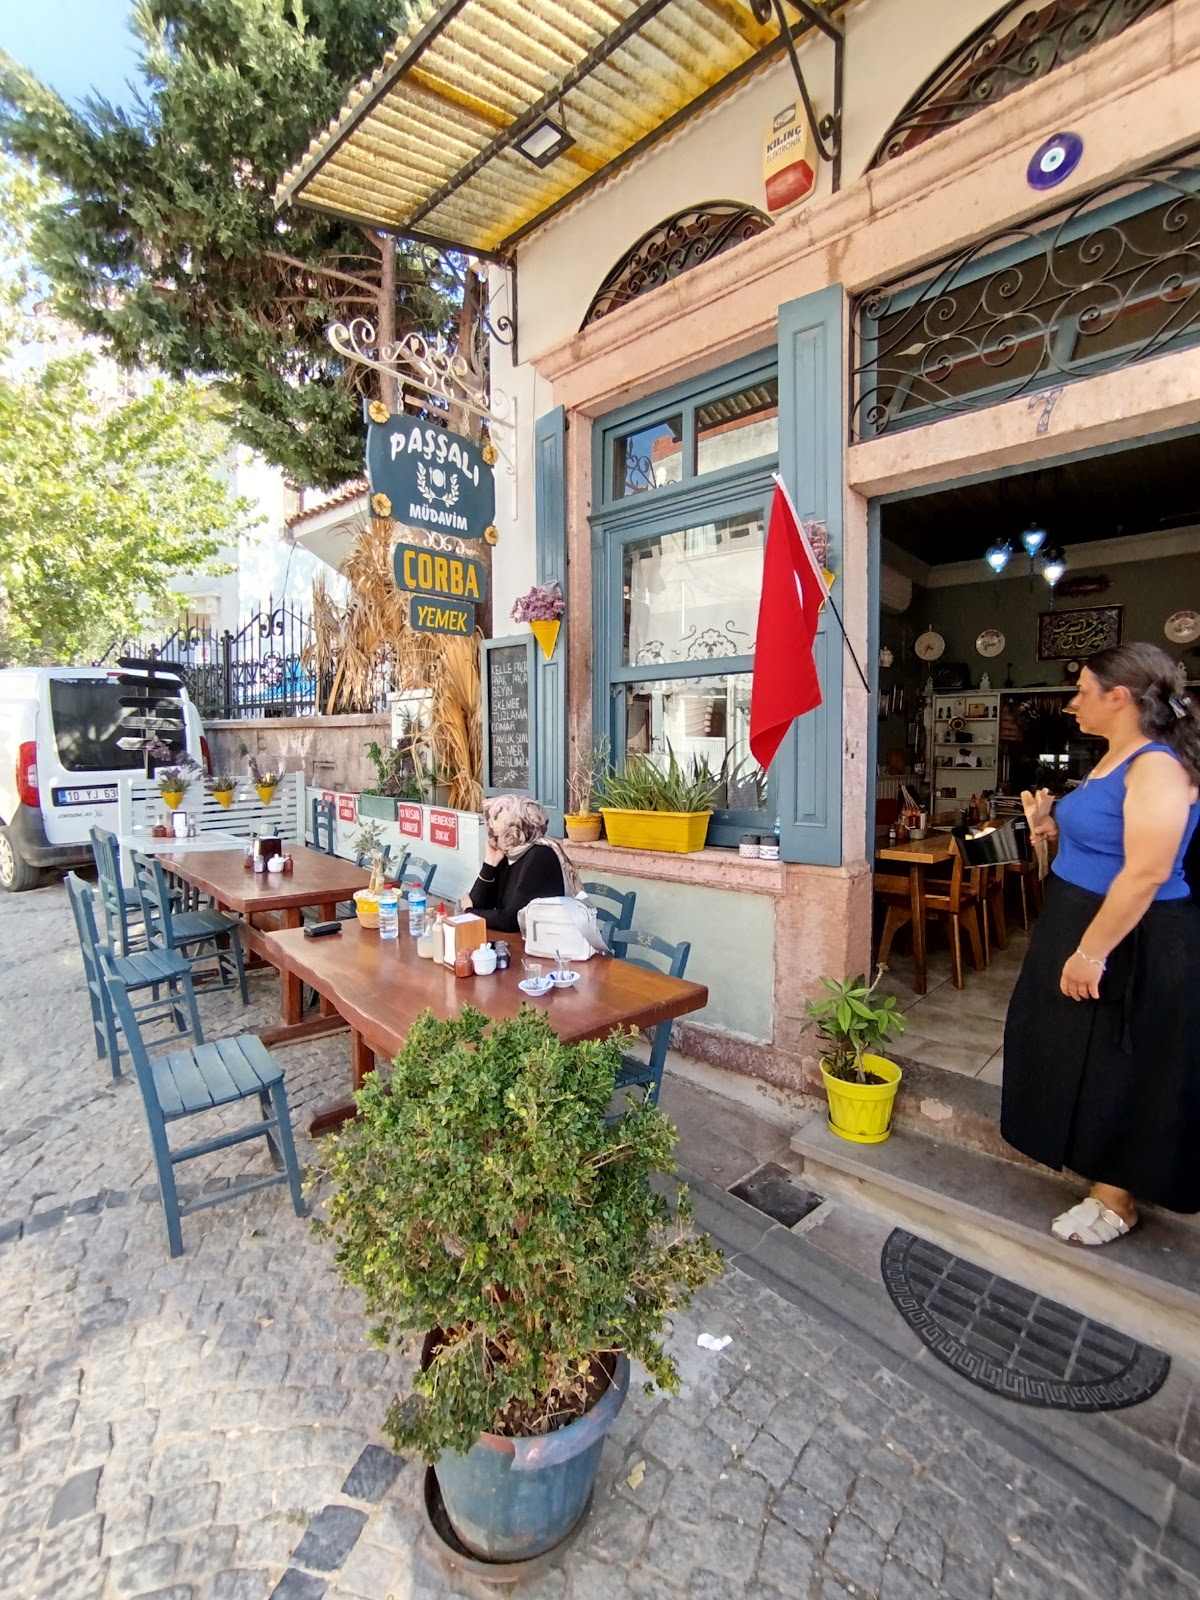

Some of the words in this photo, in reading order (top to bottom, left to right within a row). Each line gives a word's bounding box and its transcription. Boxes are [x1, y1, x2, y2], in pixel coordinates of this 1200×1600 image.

[390, 427, 480, 487] PAŞŞALI
[409, 503, 468, 531] MÜDAVİM
[417, 605, 468, 632] YEMEK
[491, 662, 512, 674] KELLE
[491, 708, 528, 722] TUZLAMA
[68, 791, 80, 801] 10
[86, 790, 99, 799] YJ
